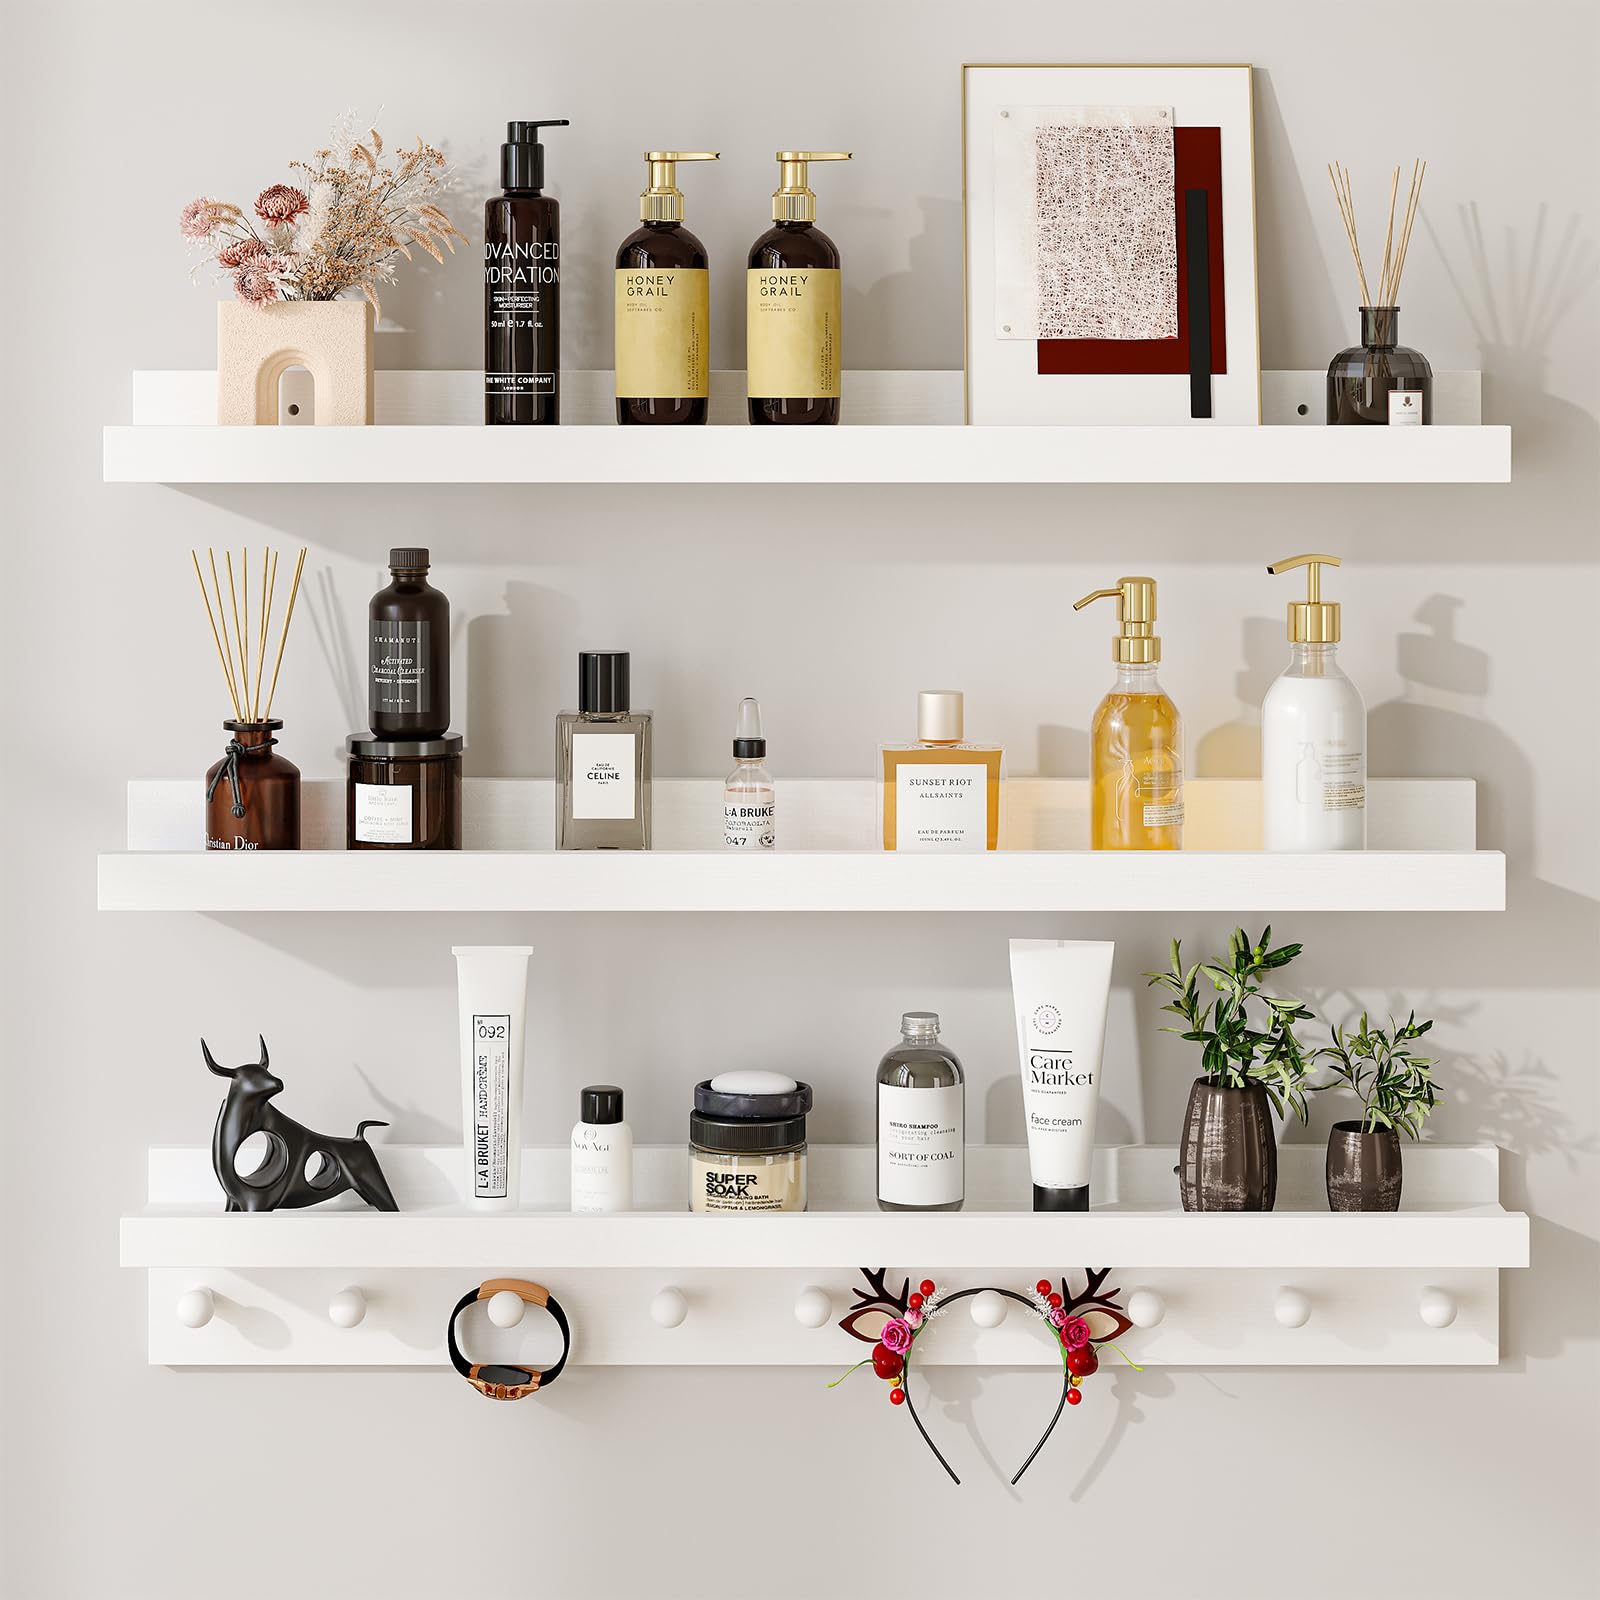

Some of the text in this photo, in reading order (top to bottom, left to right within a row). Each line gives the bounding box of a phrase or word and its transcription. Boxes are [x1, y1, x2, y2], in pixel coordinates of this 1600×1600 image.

[485, 242, 559, 260] DVANCED
[485, 266, 560, 284] YDRATION
[627, 276, 674, 285] HONEY
[760, 276, 808, 285] HONEY
[627, 287, 668, 296] GRAIL
[760, 287, 802, 296] GRAIL
[587, 772, 620, 780] CELINE
[740, 806, 775, 817] BRUKE
[234, 836, 259, 850] Dior
[726, 836, 747, 845] 047
[479, 1026, 505, 1038] 092
[1031, 1055, 1072, 1070] Care
[1031, 1070, 1094, 1085] Market
[1031, 1112, 1082, 1126] face cream
[478, 1124, 489, 1166] BRUKET
[889, 1152, 914, 1161] SORT
[931, 1151, 954, 1161] COAL
[478, 1170, 489, 1188] L:A
[706, 1171, 757, 1185] SUPER
[706, 1183, 749, 1196] SOAK
